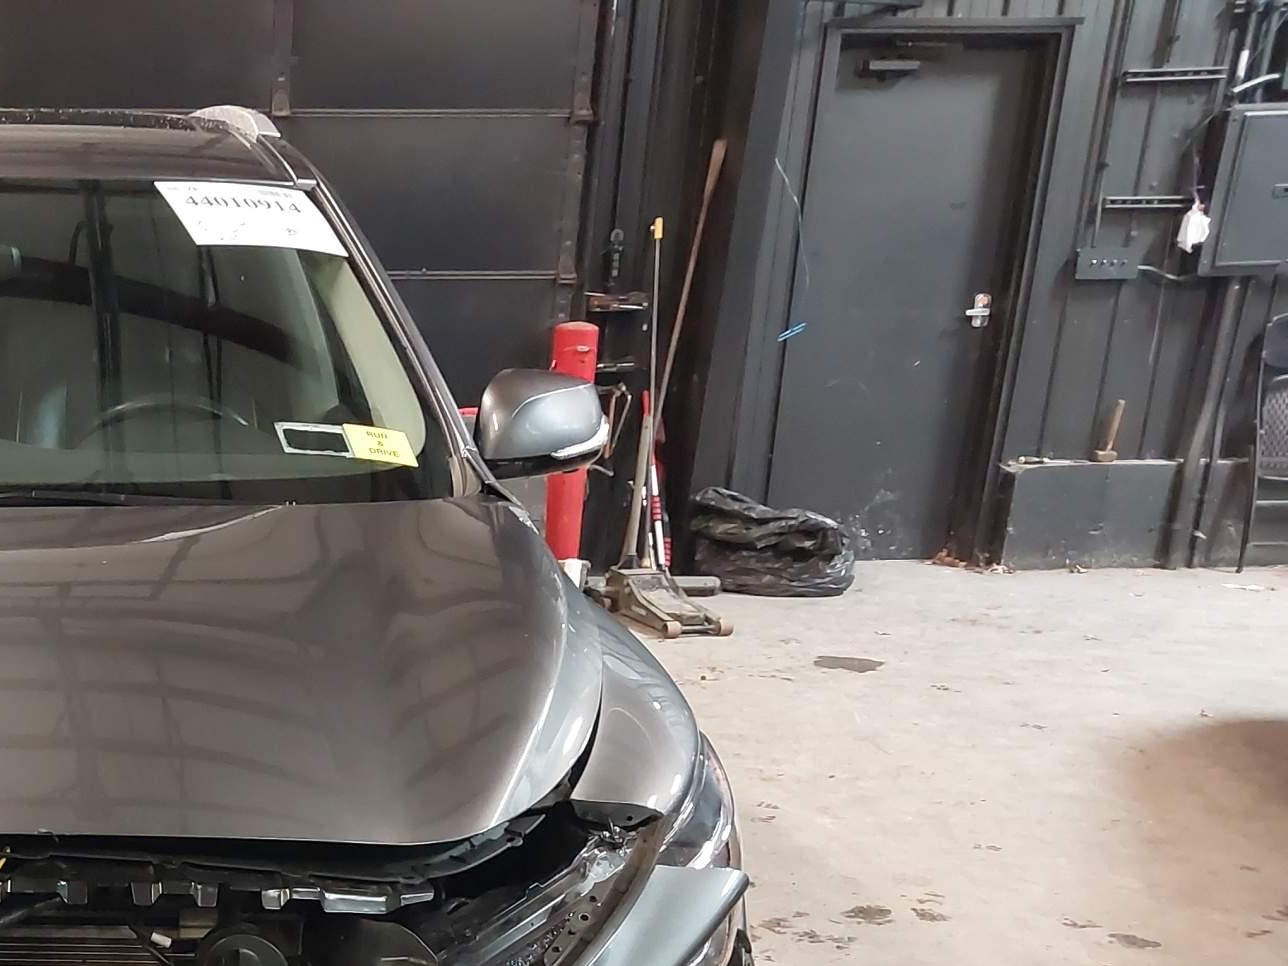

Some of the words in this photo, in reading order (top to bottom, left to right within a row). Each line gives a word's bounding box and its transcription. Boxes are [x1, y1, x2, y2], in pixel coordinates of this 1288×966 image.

[185, 195, 301, 213] 44010914
[365, 430, 388, 440] RUN
[368, 447, 400, 458] DRIVE
